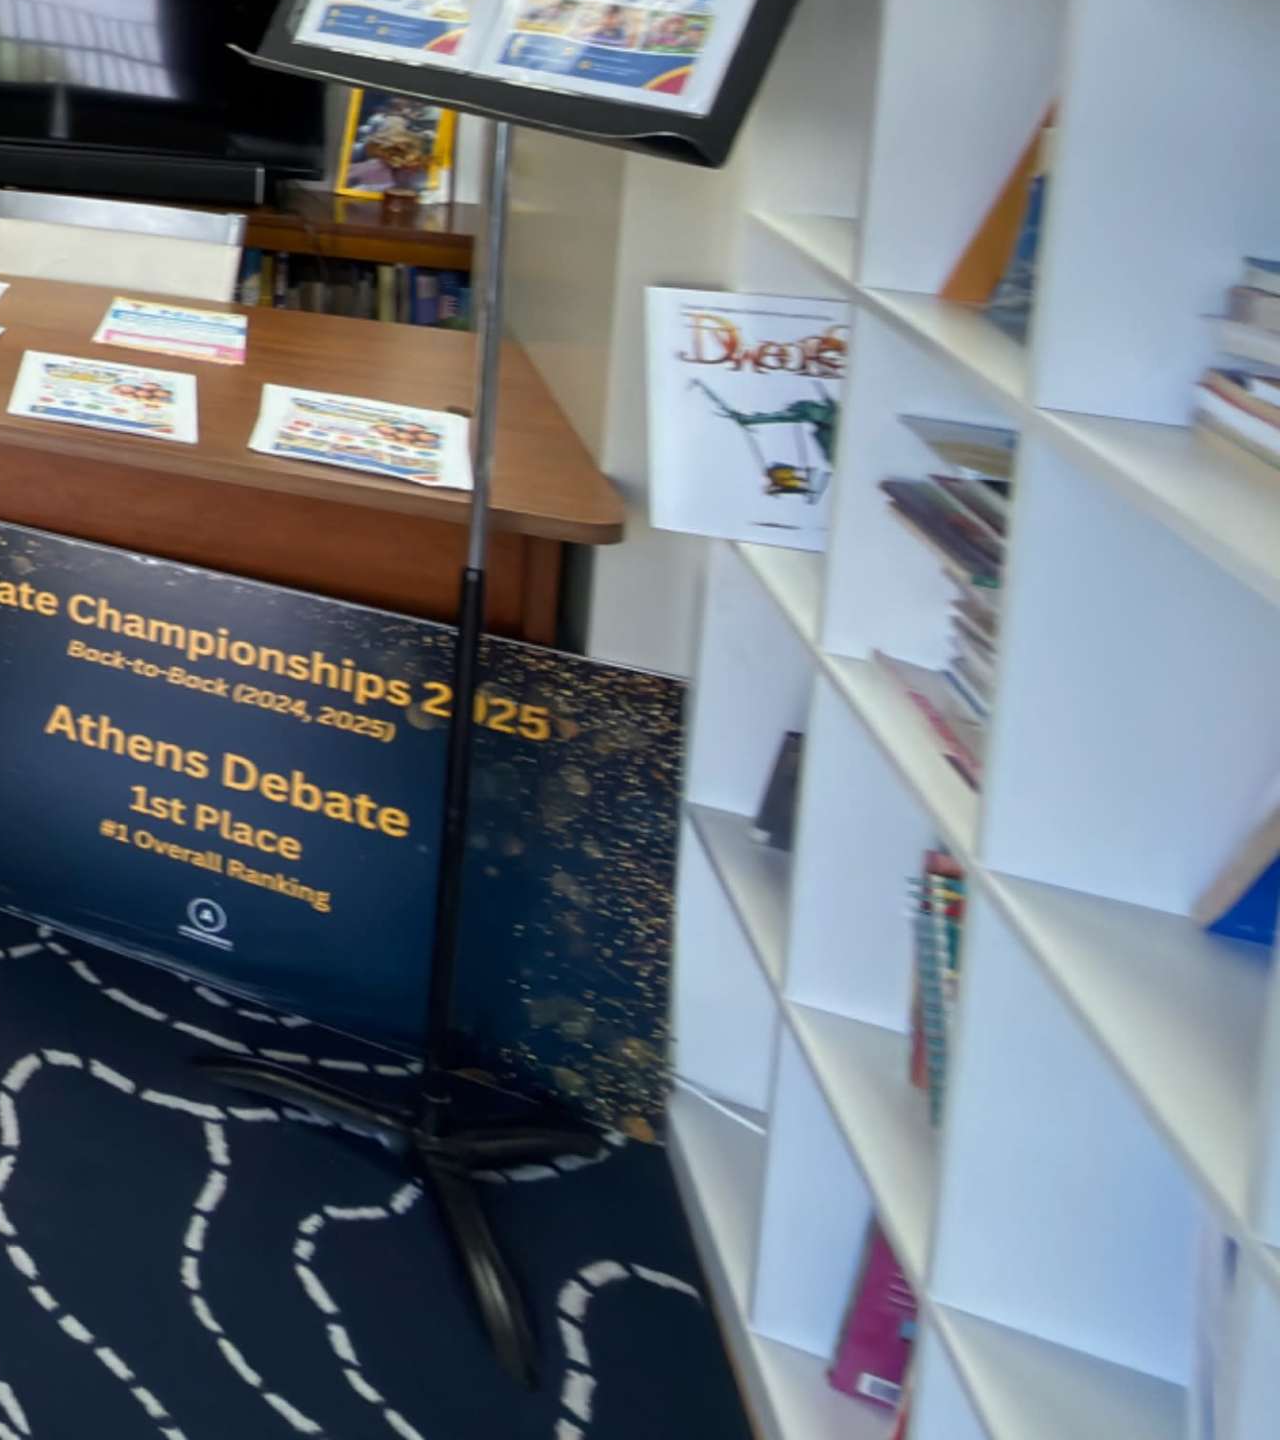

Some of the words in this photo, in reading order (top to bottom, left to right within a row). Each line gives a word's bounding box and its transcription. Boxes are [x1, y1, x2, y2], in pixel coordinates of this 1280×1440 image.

[66, 593, 412, 706] Championships
[66, 638, 230, 699] Back-to-Back
[231, 682, 313, 724] (2024,
[316, 705, 397, 744] 2025)
[44, 703, 210, 780] Athens
[221, 751, 411, 838] Debate
[129, 785, 188, 826] 1st
[193, 803, 303, 861] Place
[99, 818, 130, 845] #1
[132, 829, 224, 874] Overall
[225, 858, 333, 913] Ranking
